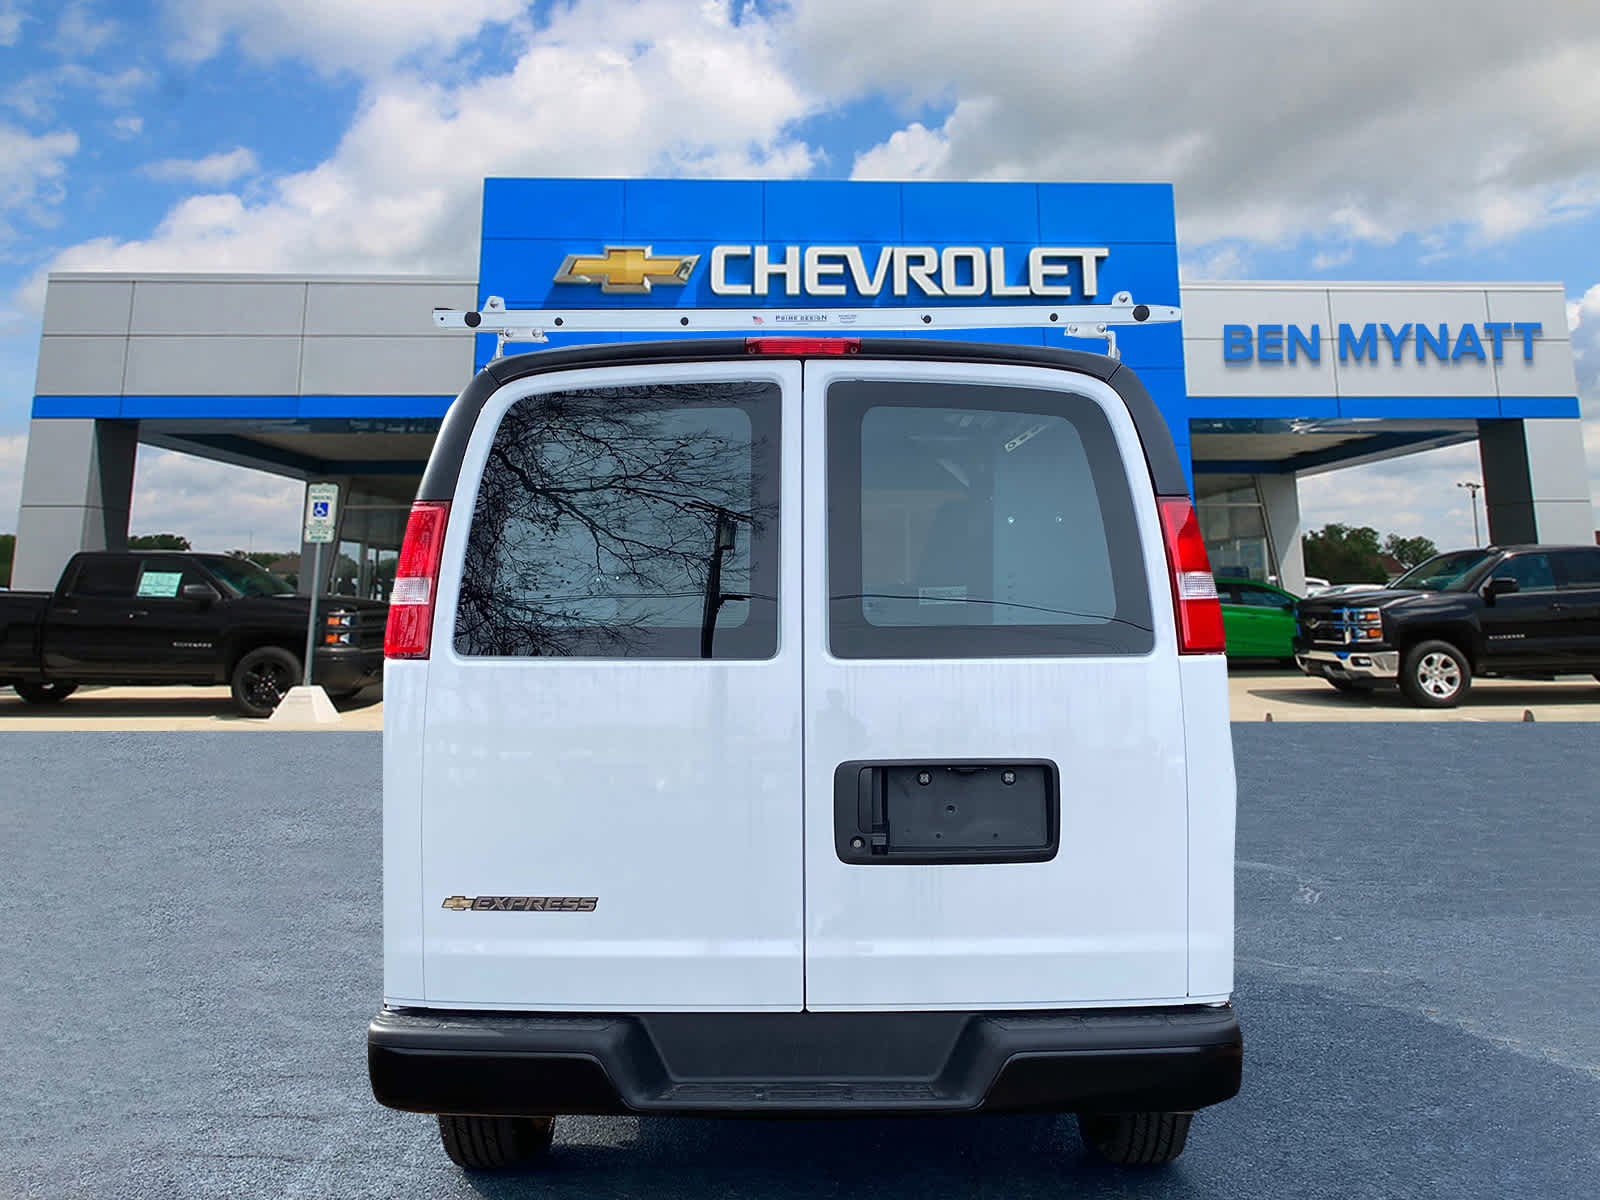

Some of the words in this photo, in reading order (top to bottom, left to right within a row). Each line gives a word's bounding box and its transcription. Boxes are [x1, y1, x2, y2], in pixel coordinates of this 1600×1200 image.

[711, 245, 1109, 296] CHEVROLET
[1223, 324, 1321, 362] BEN
[1338, 322, 1543, 362] MYNATT
[472, 896, 598, 911] EXPRESS
